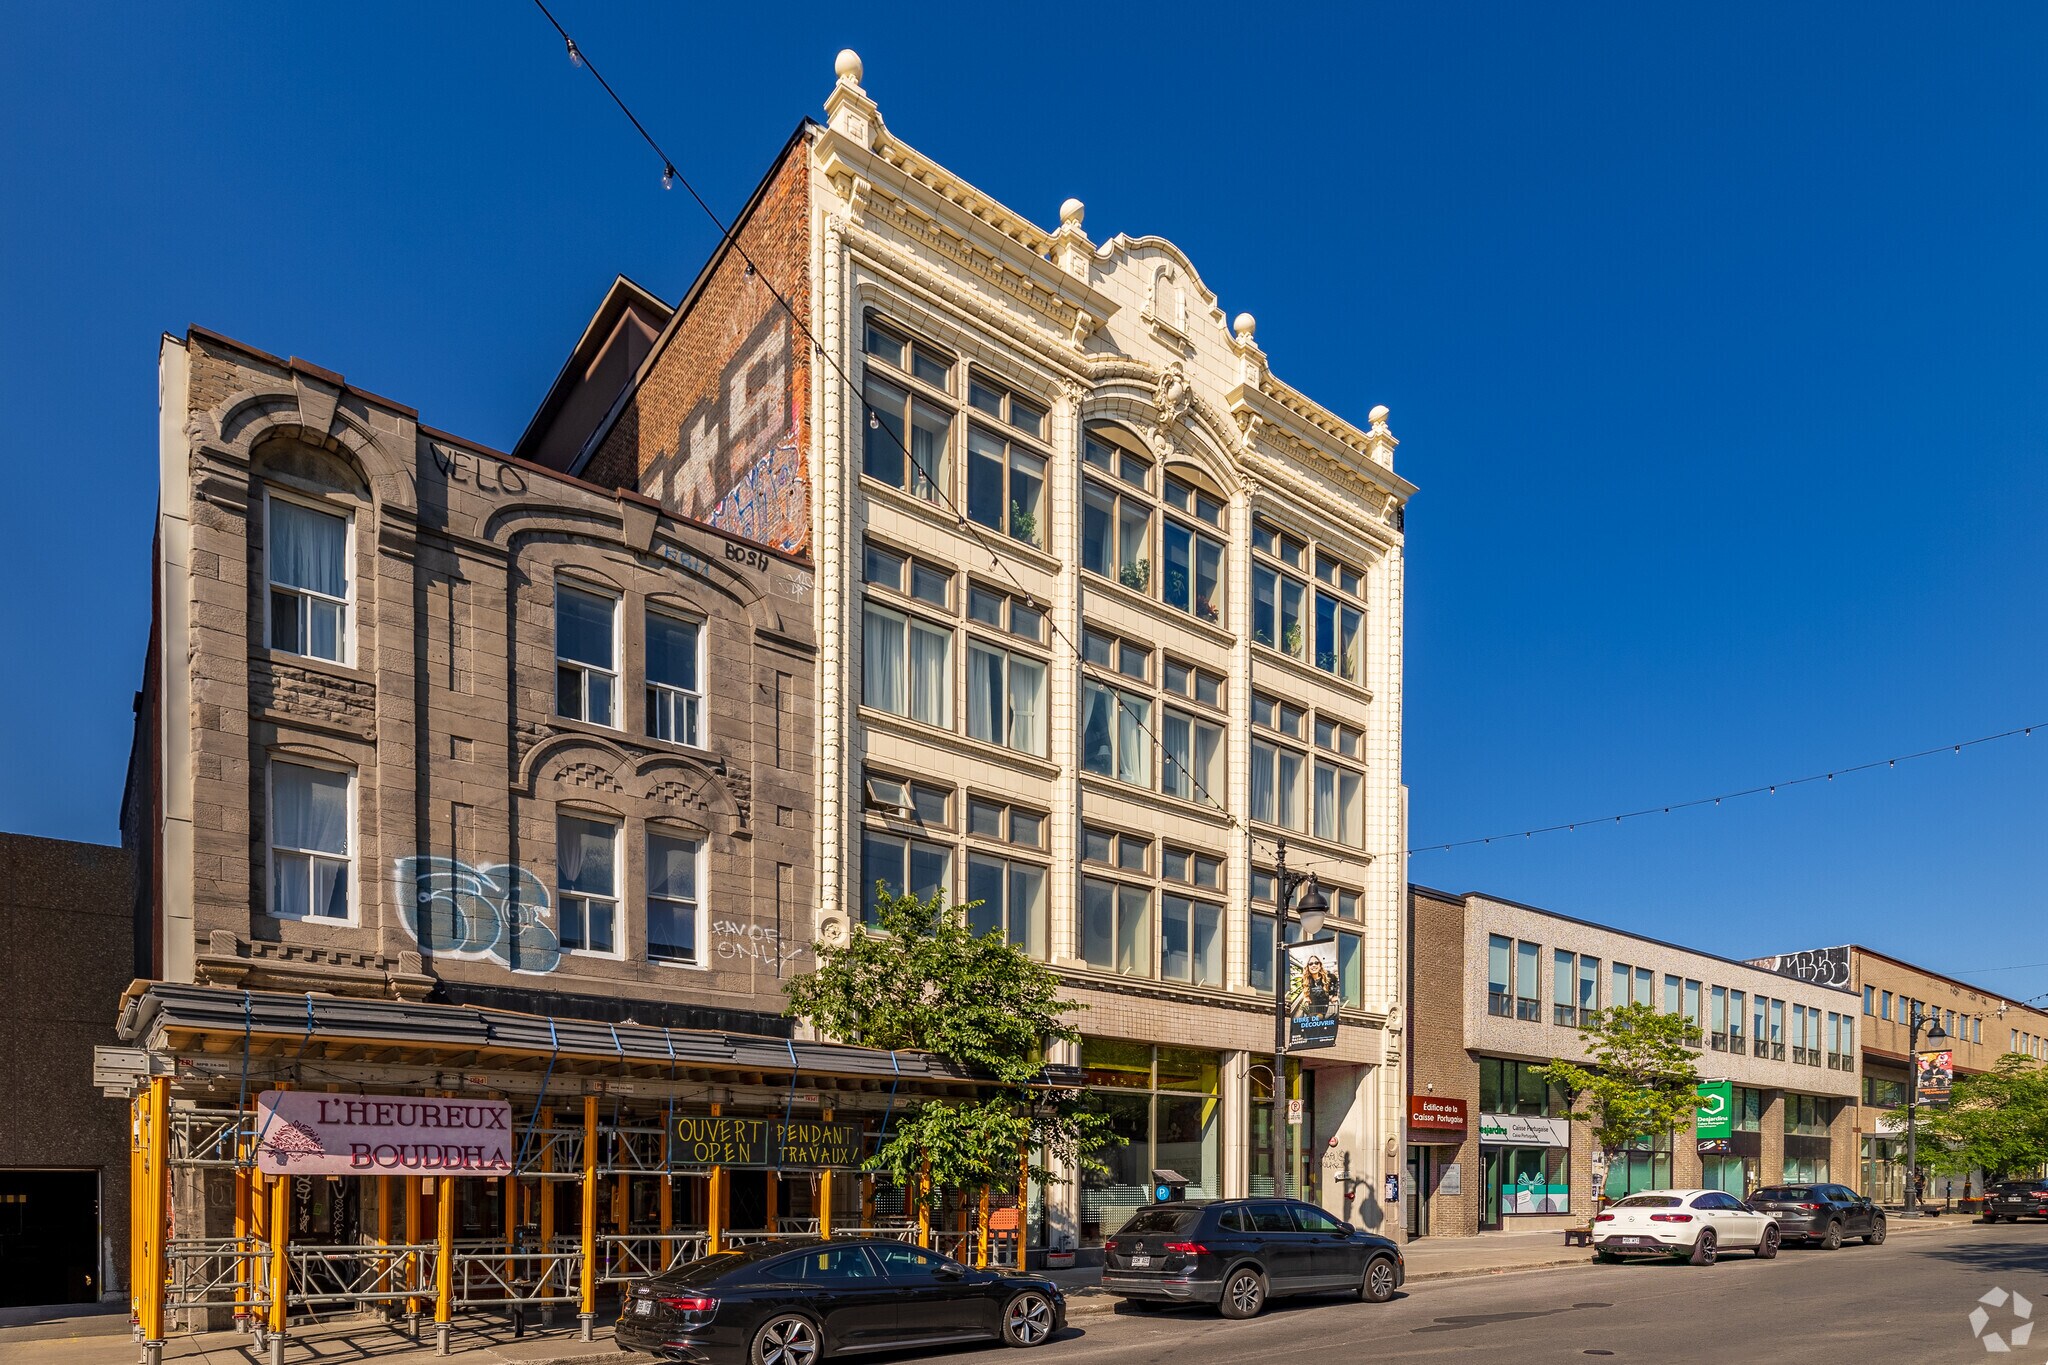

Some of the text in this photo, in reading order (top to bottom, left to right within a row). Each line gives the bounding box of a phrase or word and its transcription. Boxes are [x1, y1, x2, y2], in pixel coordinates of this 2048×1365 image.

[429, 442, 528, 495] VELO
[725, 541, 769, 573] BOSH
[712, 920, 782, 943] FAVOR
[718, 941, 802, 979] ONLY
[317, 1098, 507, 1130] L'HEUREUX
[1413, 1113, 1463, 1124] Caisse Portugaise
[1423, 1101, 1443, 1111] Édifice
[1452, 1105, 1458, 1113] la
[678, 1119, 763, 1143] OUVERT
[777, 1124, 853, 1146] PENDANT
[1479, 1125, 1507, 1136] esjardins
[1527, 1125, 1549, 1133] Portugaise
[349, 1143, 510, 1170] BOUDDHA
[694, 1142, 750, 1163] OPEN
[780, 1147, 858, 1164] TRAVAUX!
